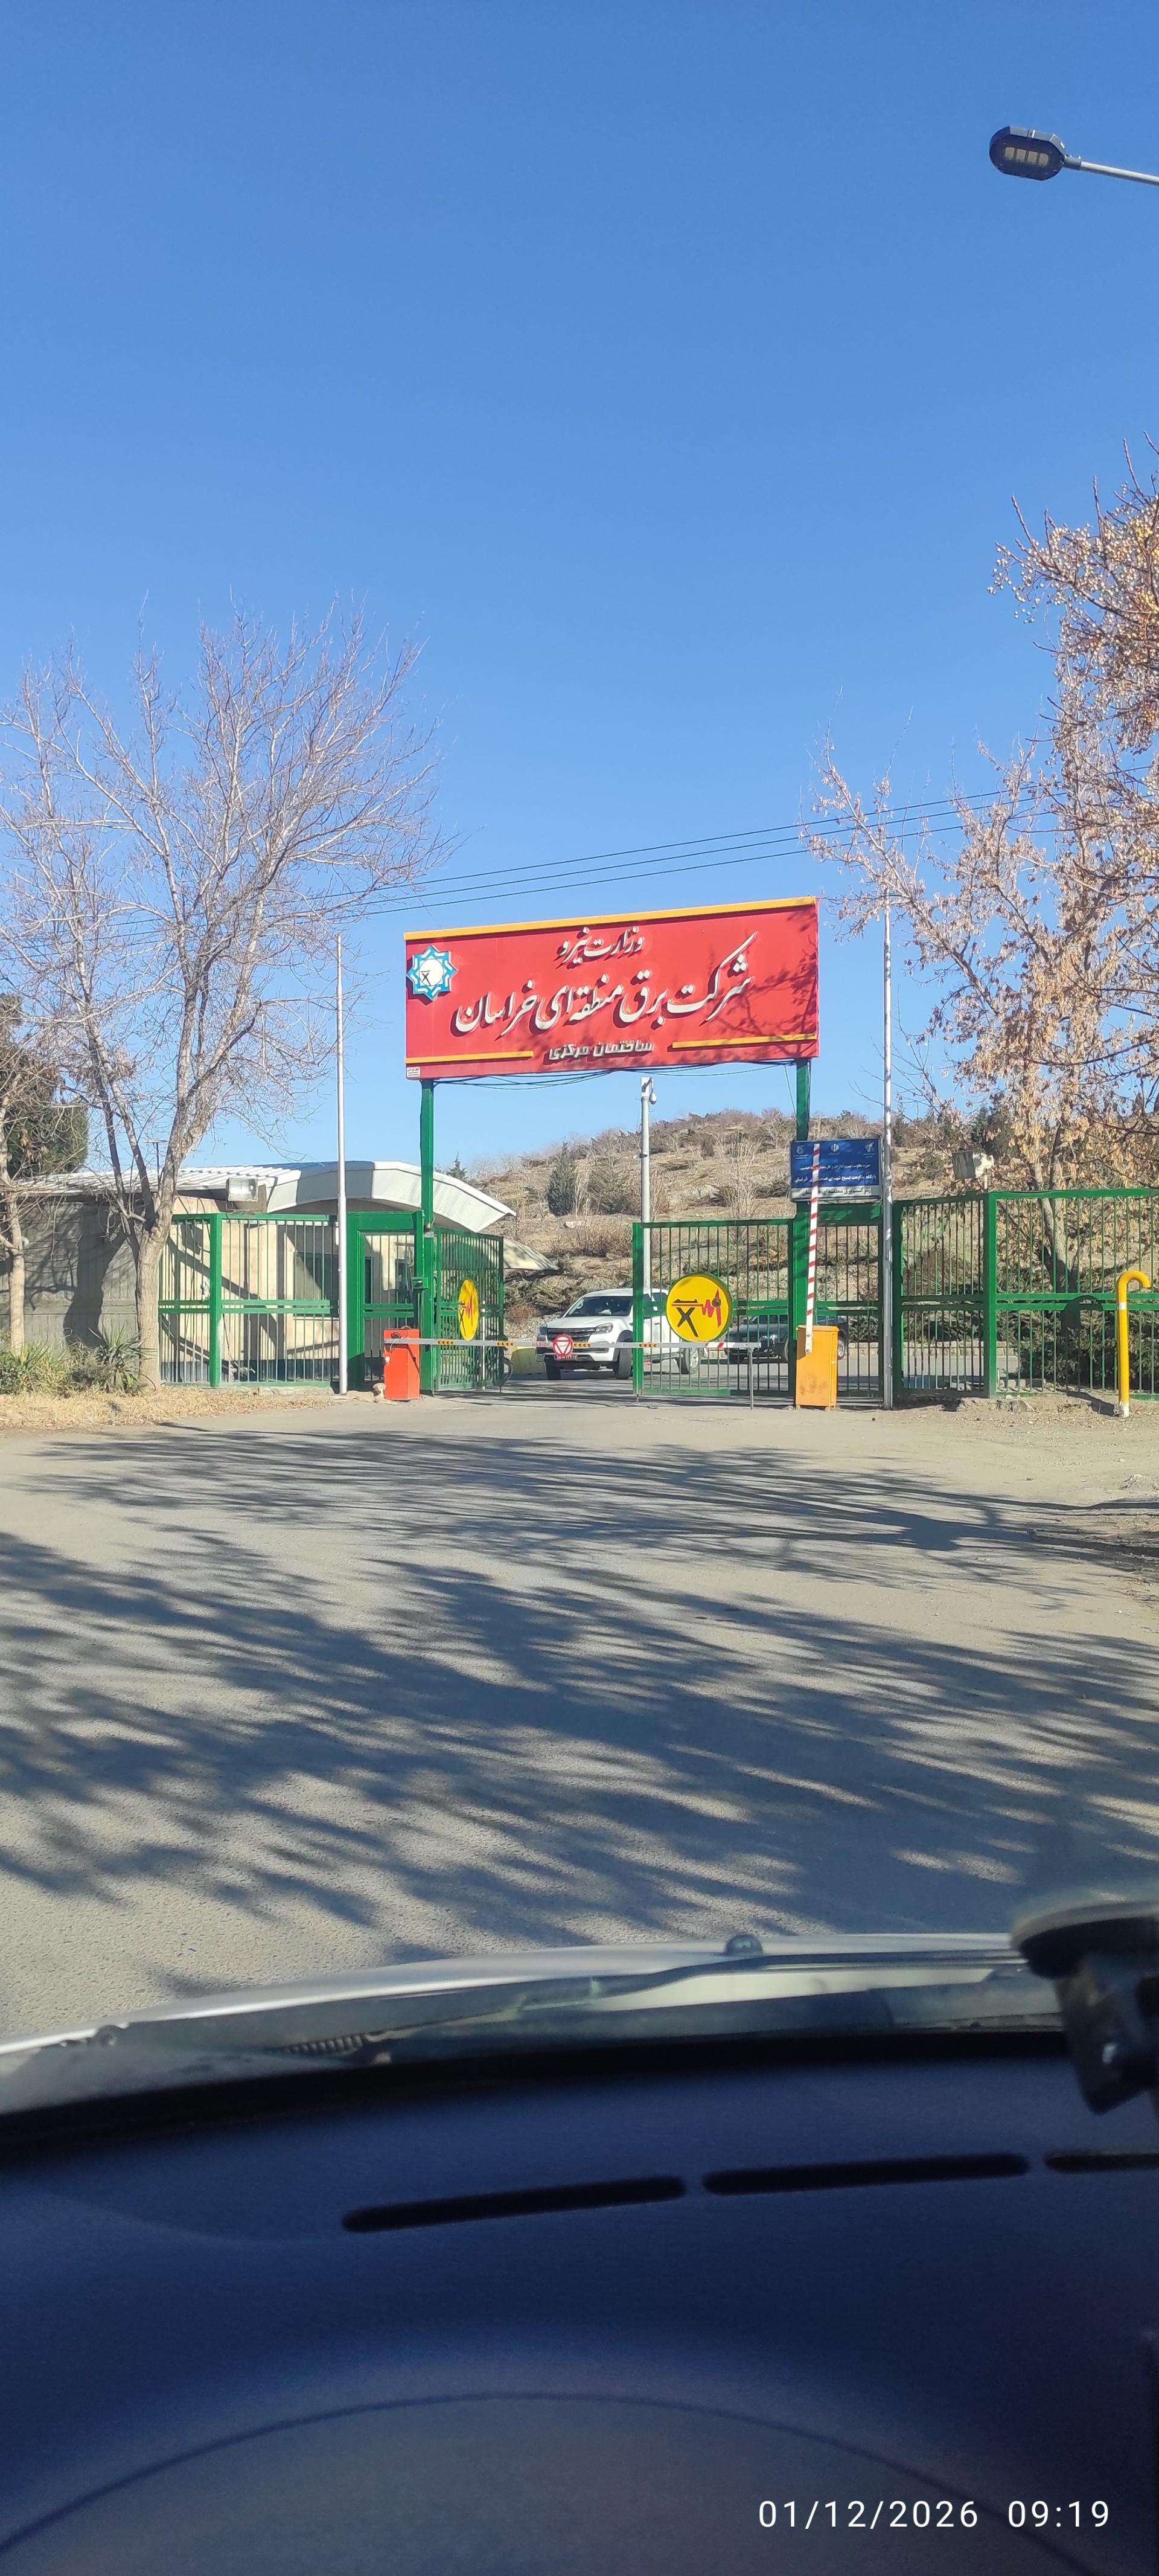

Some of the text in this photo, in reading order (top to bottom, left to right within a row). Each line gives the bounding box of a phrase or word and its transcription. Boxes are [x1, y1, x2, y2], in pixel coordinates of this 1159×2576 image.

[559, 926, 644, 964] وزارت نیرو
[619, 969, 668, 1025] برق
[667, 931, 758, 1022] شرکت
[455, 979, 538, 1036] خراسان
[549, 1039, 654, 1061] ساختمان مرکزی
